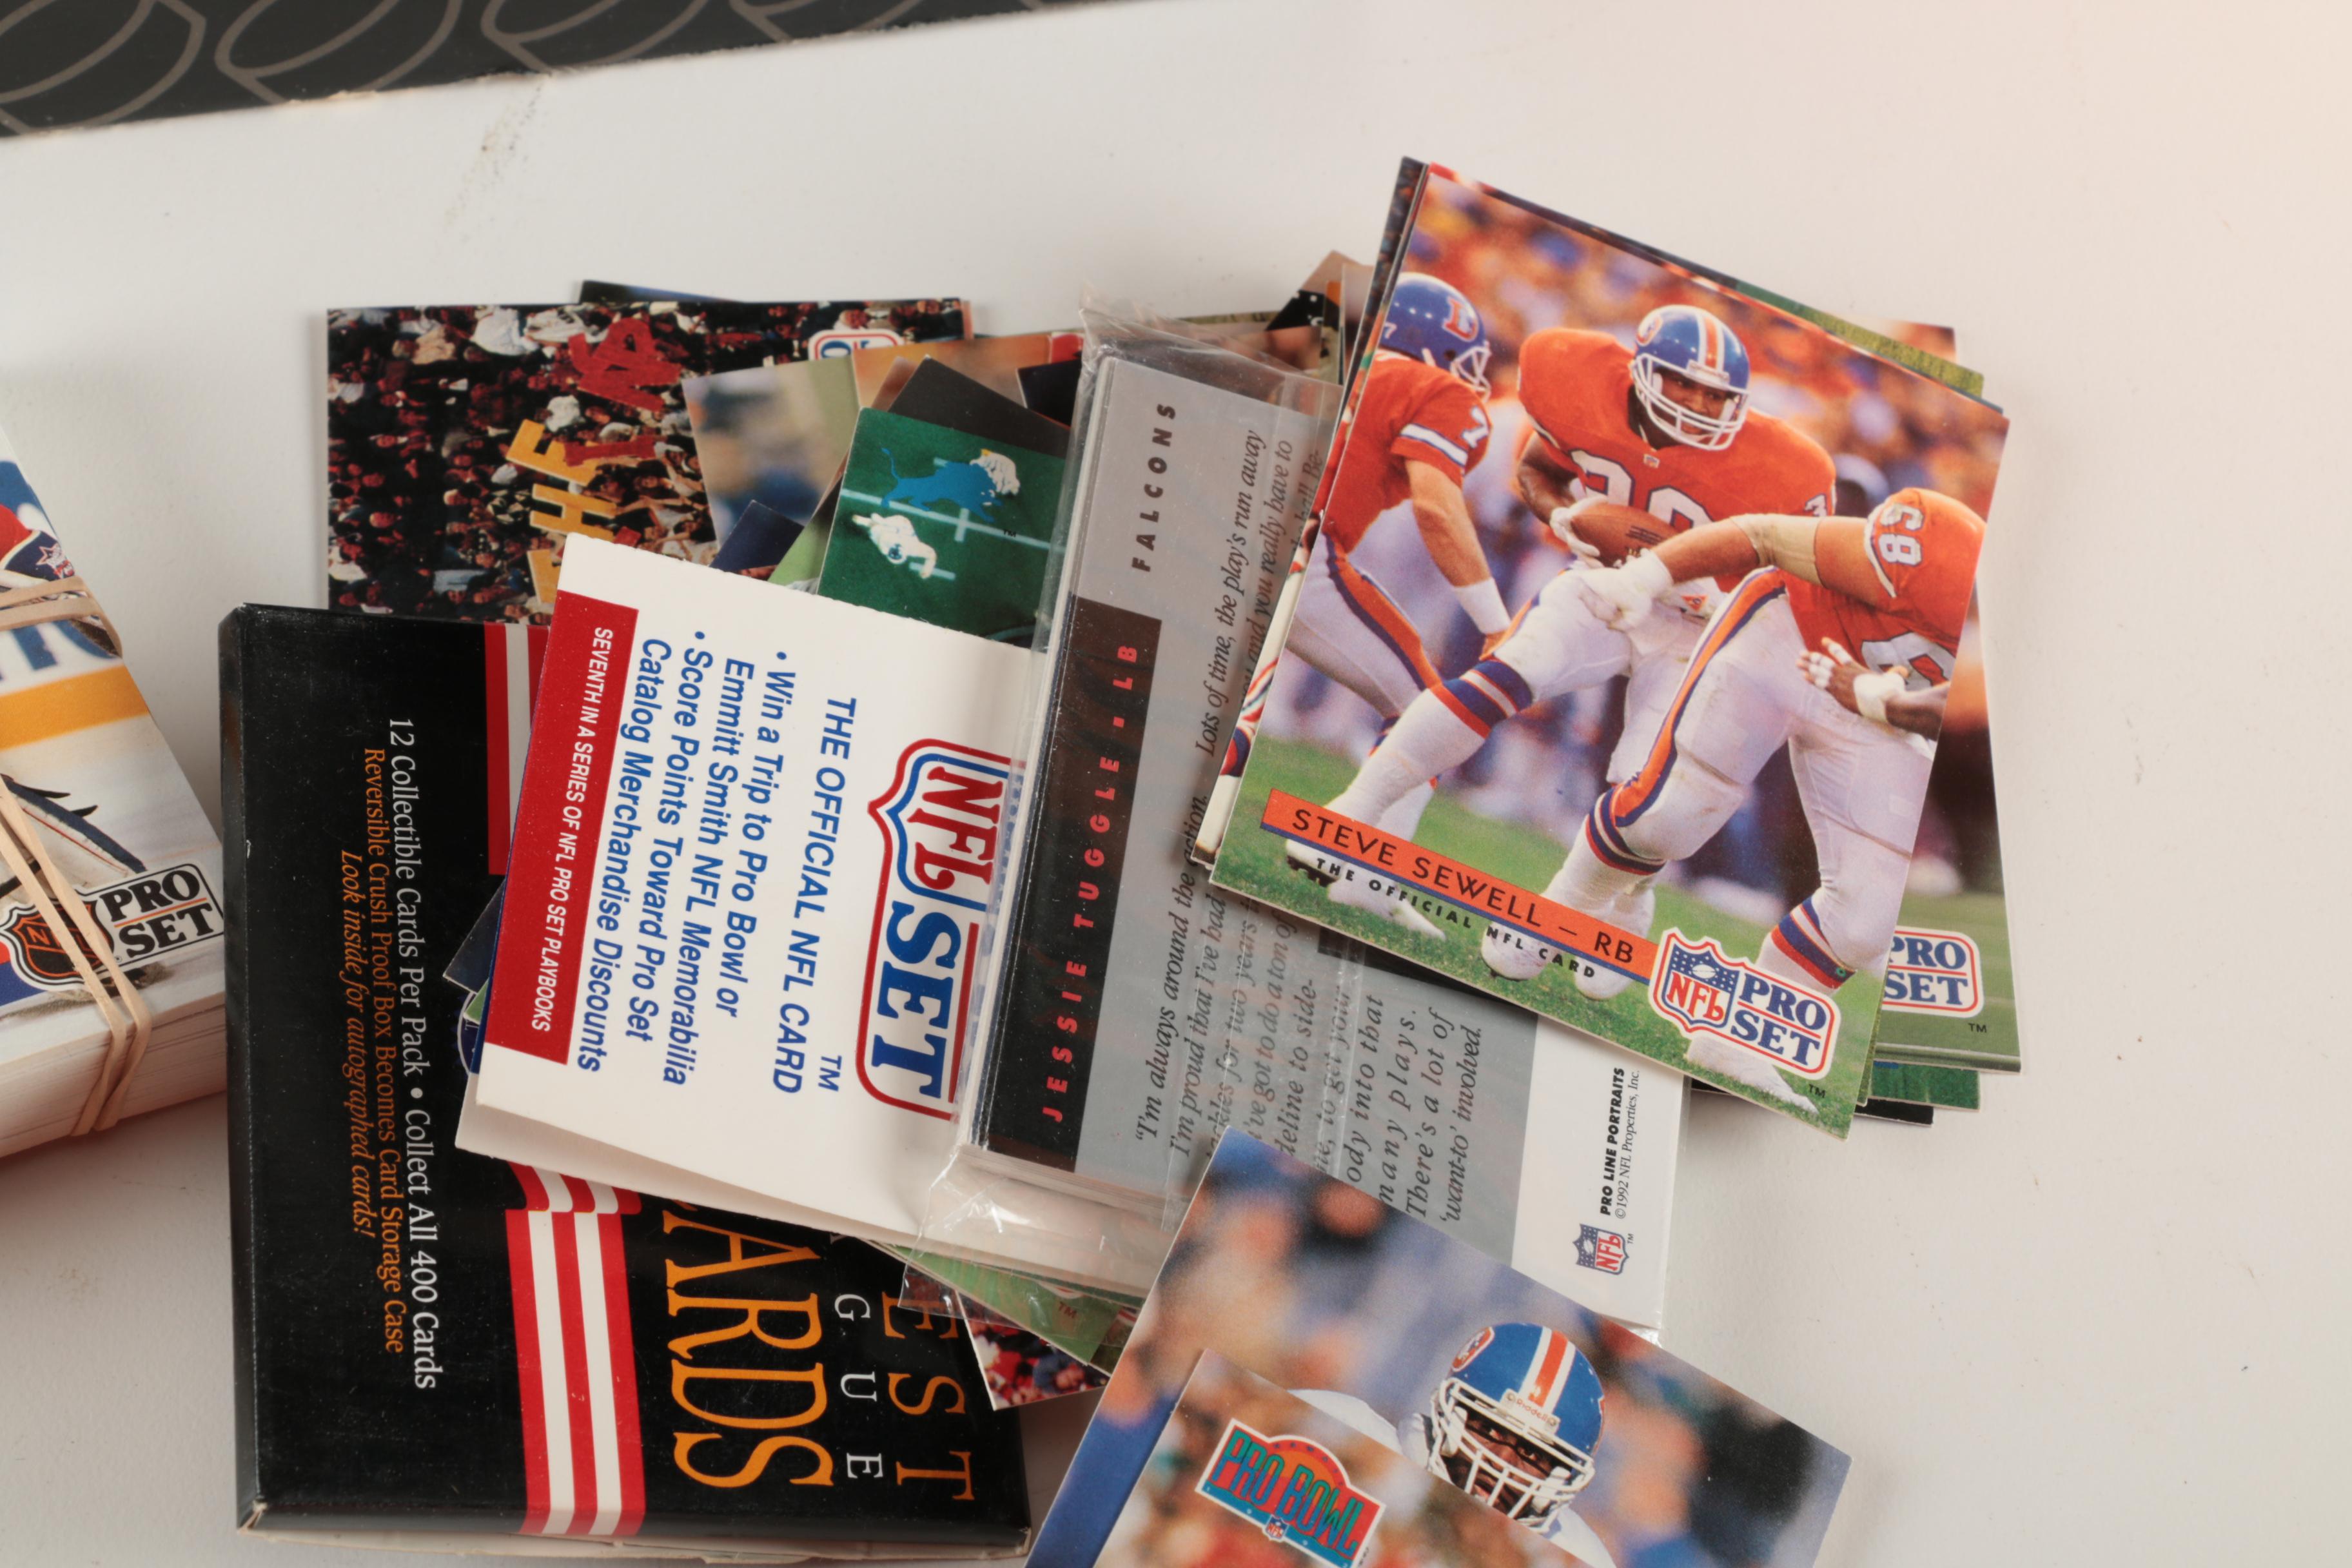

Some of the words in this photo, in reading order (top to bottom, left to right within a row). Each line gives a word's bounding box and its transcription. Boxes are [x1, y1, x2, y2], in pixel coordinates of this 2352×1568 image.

[1131, 404, 1176, 573] FALCONS
[583, 627, 614, 704] SEVENTH
[621, 639, 672, 743] Catalog
[674, 647, 713, 727] Score
[761, 671, 796, 720] Win
[389, 719, 415, 746] 12
[577, 725, 596, 737] A
[580, 705, 600, 724] IN
[712, 658, 755, 756] Emmitt
[757, 726, 780, 743] a
[820, 698, 857, 760] THE
[364, 748, 391, 856] Reversible
[565, 741, 594, 803] SERIES
[657, 734, 700, 825] Points
[741, 754, 784, 804] Trip
[391, 755, 422, 879] Collectible
[562, 806, 582, 830] OF
[698, 762, 739, 845] Smith
[742, 812, 772, 841] to
[906, 766, 1004, 890] NFL
[555, 832, 578, 862] NFL
[596, 750, 654, 932] Merchandise
[794, 767, 845, 919] OFFICIAL
[99, 870, 200, 923] PRO
[341, 850, 367, 903] Look
[368, 863, 393, 923] Crush
[550, 867, 573, 902] PRO
[639, 837, 683, 940] Toward
[685, 854, 723, 912] NFL
[732, 850, 768, 902] Pro
[1043, 961, 1087, 1122] JESSIE
[1073, 756, 1120, 928] TUGGLE
[1113, 645, 1137, 690] LB
[1292, 808, 1396, 866] STEVE
[1412, 856, 1541, 927] SEWELL
[1594, 931, 1634, 963] RB
[119, 903, 213, 959] SET
[344, 909, 369, 972] inside
[396, 888, 426, 957] Cards
[545, 904, 567, 937] SET
[720, 910, 757, 983] Bowl
[1316, 859, 1355, 881] THE
[1369, 880, 1471, 928] OFFICIAL
[1487, 927, 1522, 948] NFL
[1539, 948, 1594, 977] CARD
[371, 932, 397, 991] Proof
[399, 966, 425, 1008] Per
[531, 937, 562, 1032] PLAYBOOKS
[632, 944, 665, 990] Pro
[783, 930, 820, 992] NFL
[1883, 970, 1968, 1005] SET
[338, 969, 370, 1014] for
[373, 996, 395, 1038] Box
[577, 938, 623, 1072] Discounts
[625, 996, 660, 1042] Set
[663, 921, 712, 1085] Memorabilia
[716, 987, 739, 1018] or
[871, 901, 962, 1099] SET
[1666, 971, 1725, 1022] NFL
[1739, 972, 1827, 1032] PRO
[401, 1016, 431, 1077] Pack
[773, 1003, 810, 1093] CARD
[1730, 1008, 1820, 1067] SET
[1968, 1023, 1988, 1033] TM
[342, 1017, 376, 1160] autographed
[375, 1046, 397, 1141] Becomes
[1274, 1081, 1304, 1156] deline
[1607, 1067, 1625, 1145] PORTRAITS
[1808, 1083, 1827, 1099] TM
[379, 1149, 405, 1199] Card
[405, 1109, 435, 1195] Collect
[1343, 1130, 1372, 1183] ody
[1603, 1148, 1617, 1181] LINE
[1619, 1155, 1631, 1179] NFL
[351, 1164, 377, 1238] cards!
[408, 1202, 438, 1241] All
[1600, 1186, 1613, 1215] PRO
[377, 1206, 404, 1293] Storage
[410, 1250, 438, 1303] 400
[1595, 1233, 1622, 1271] NFL
[384, 1299, 407, 1353] Case
[412, 1311, 444, 1389] Cards
[662, 1199, 834, 1488] ARDS
[1211, 1428, 1285, 1506] PRO
[1275, 1464, 1365, 1557] BOWL
